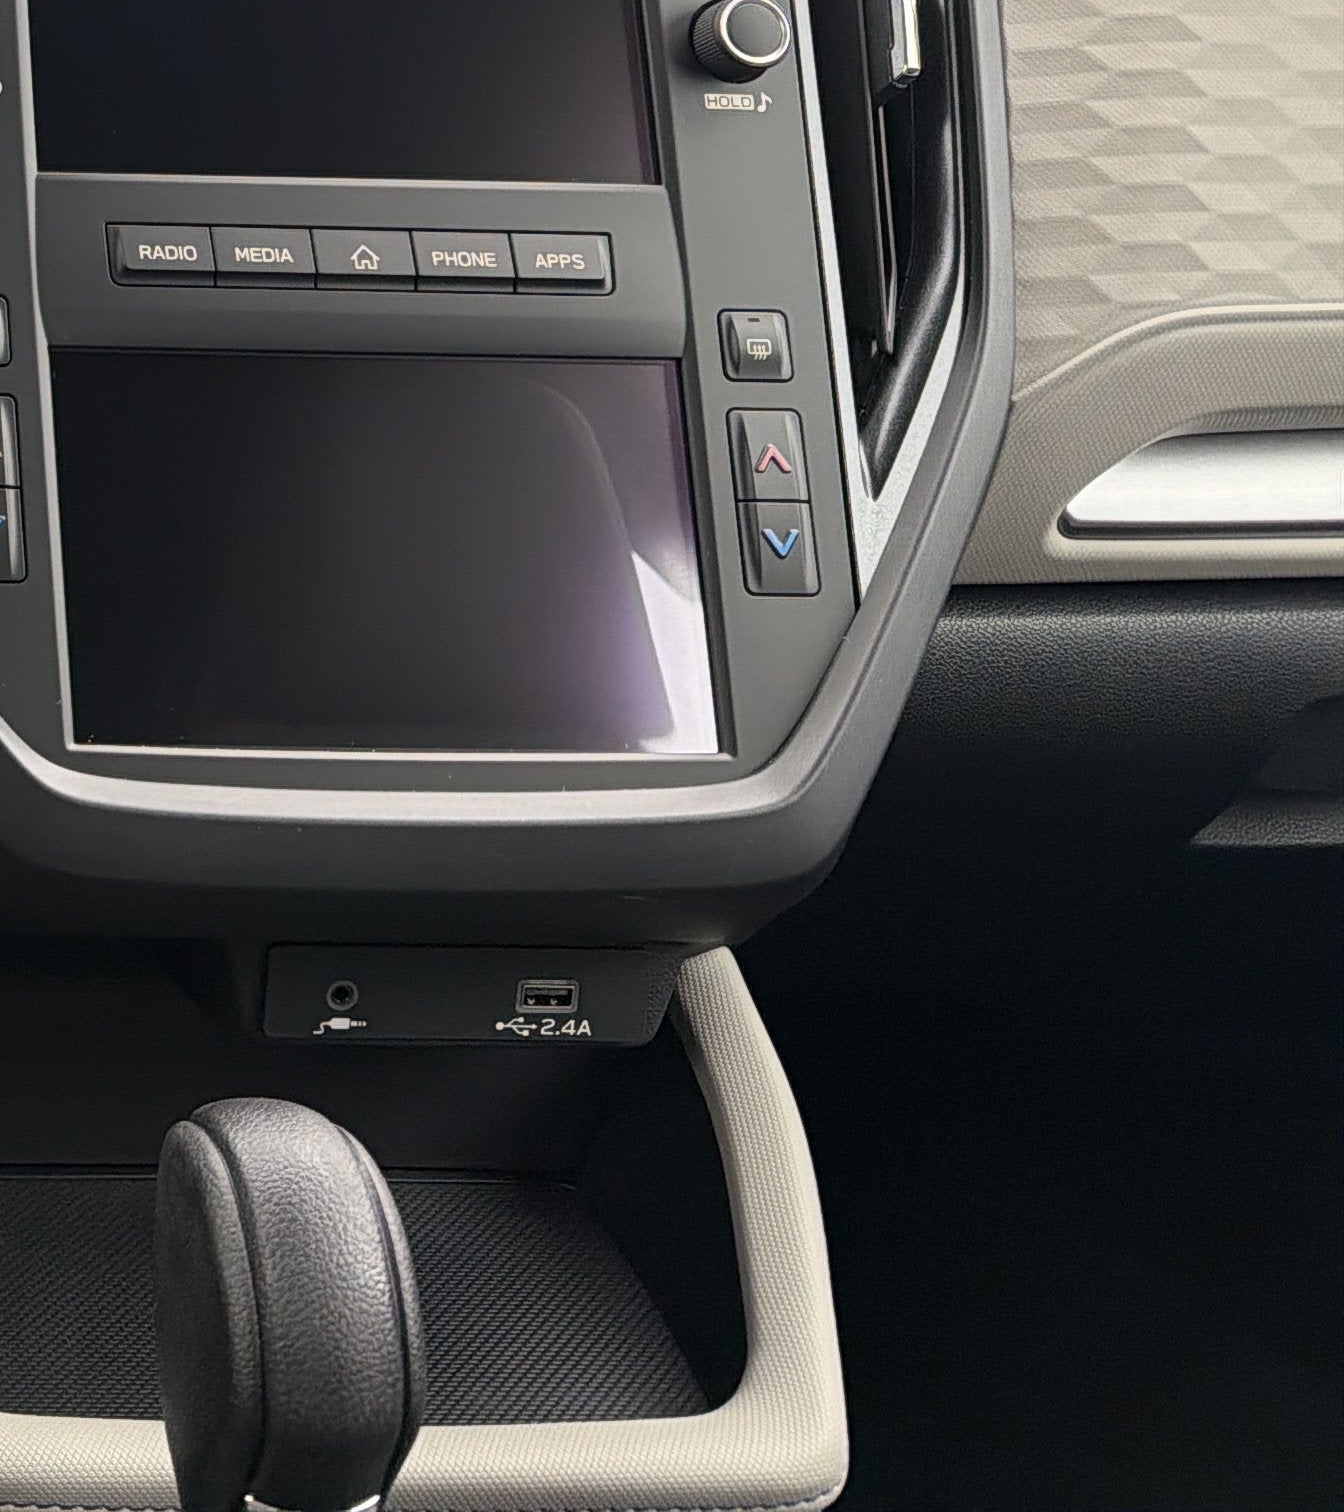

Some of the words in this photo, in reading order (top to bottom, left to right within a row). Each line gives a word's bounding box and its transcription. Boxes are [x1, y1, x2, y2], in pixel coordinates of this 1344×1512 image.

[705, 94, 753, 109] HOLD
[137, 244, 198, 262] RADIO
[234, 246, 294, 264] MEDIA
[431, 250, 498, 268] PHONE
[534, 253, 586, 270] APPS
[539, 1019, 592, 1037] 2.4A
